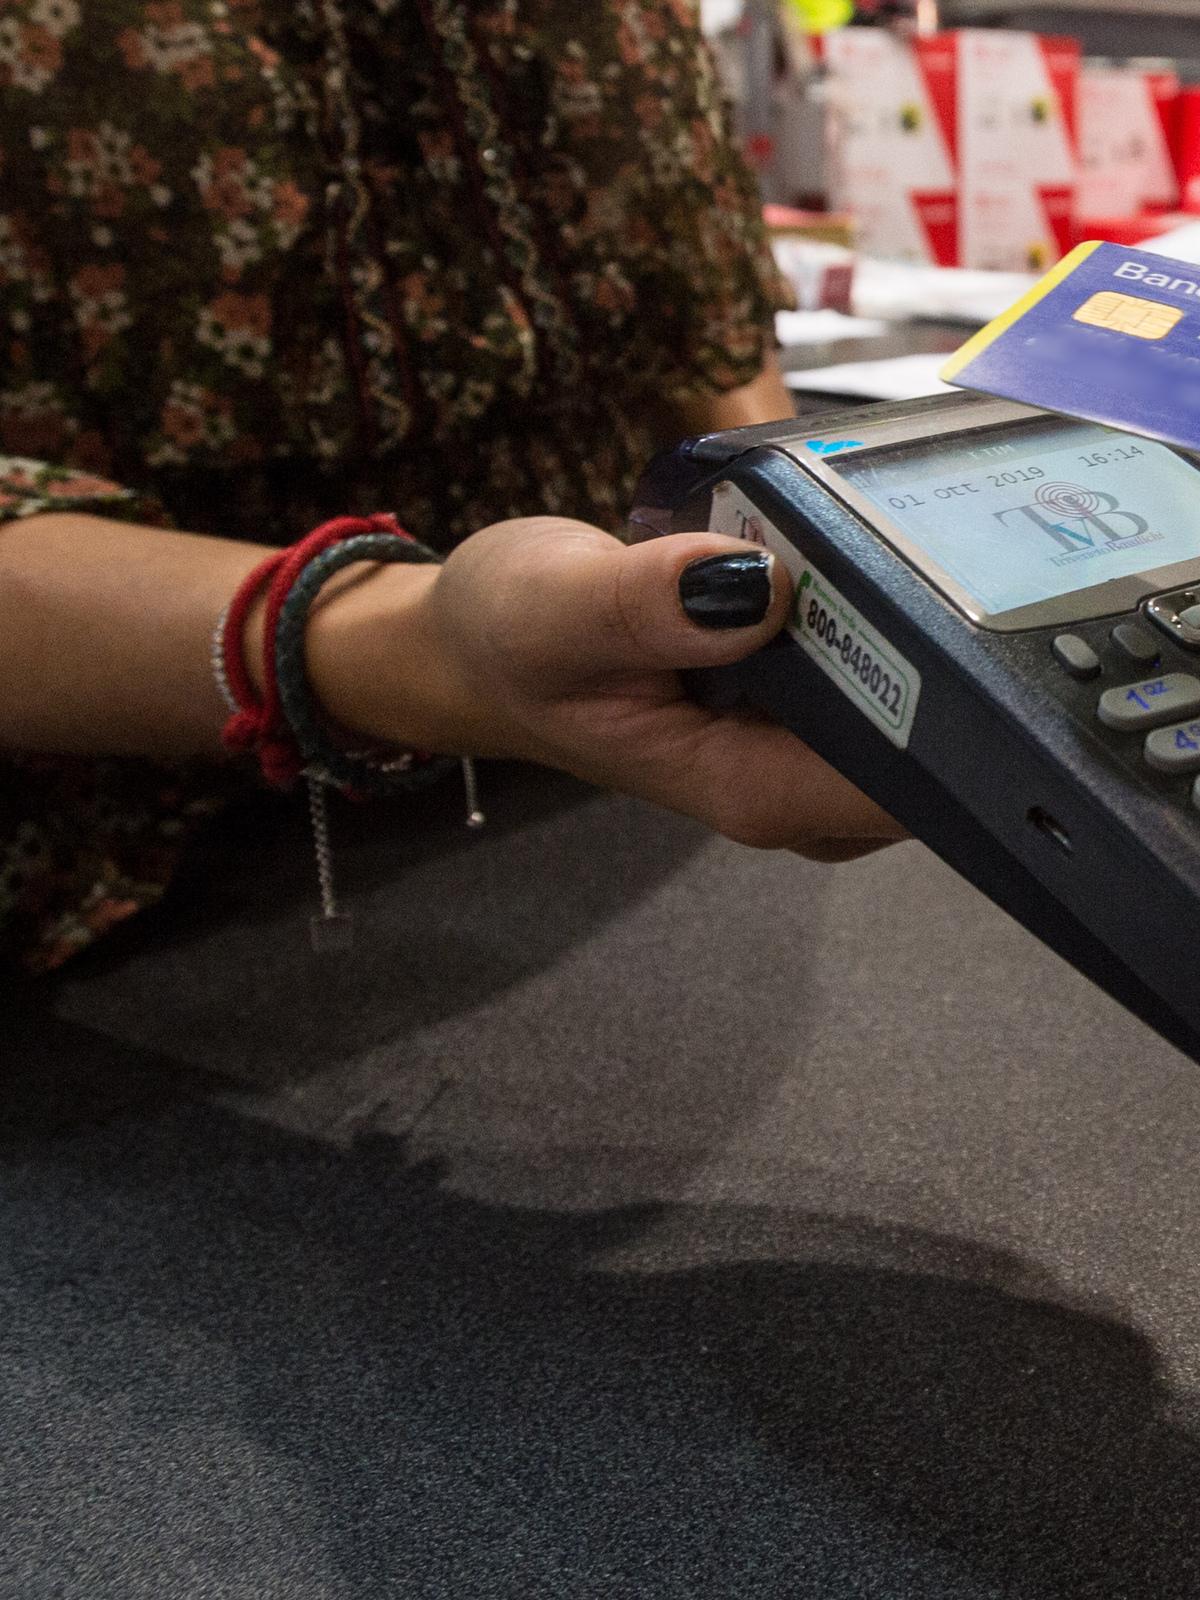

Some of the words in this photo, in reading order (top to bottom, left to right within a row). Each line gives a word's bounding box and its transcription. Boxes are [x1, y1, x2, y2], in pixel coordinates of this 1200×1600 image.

[887, 493, 926, 511] 01
[986, 465, 1046, 488] 2019
[1077, 444, 1145, 468] 16:14
[806, 599, 902, 717] 800-848022
